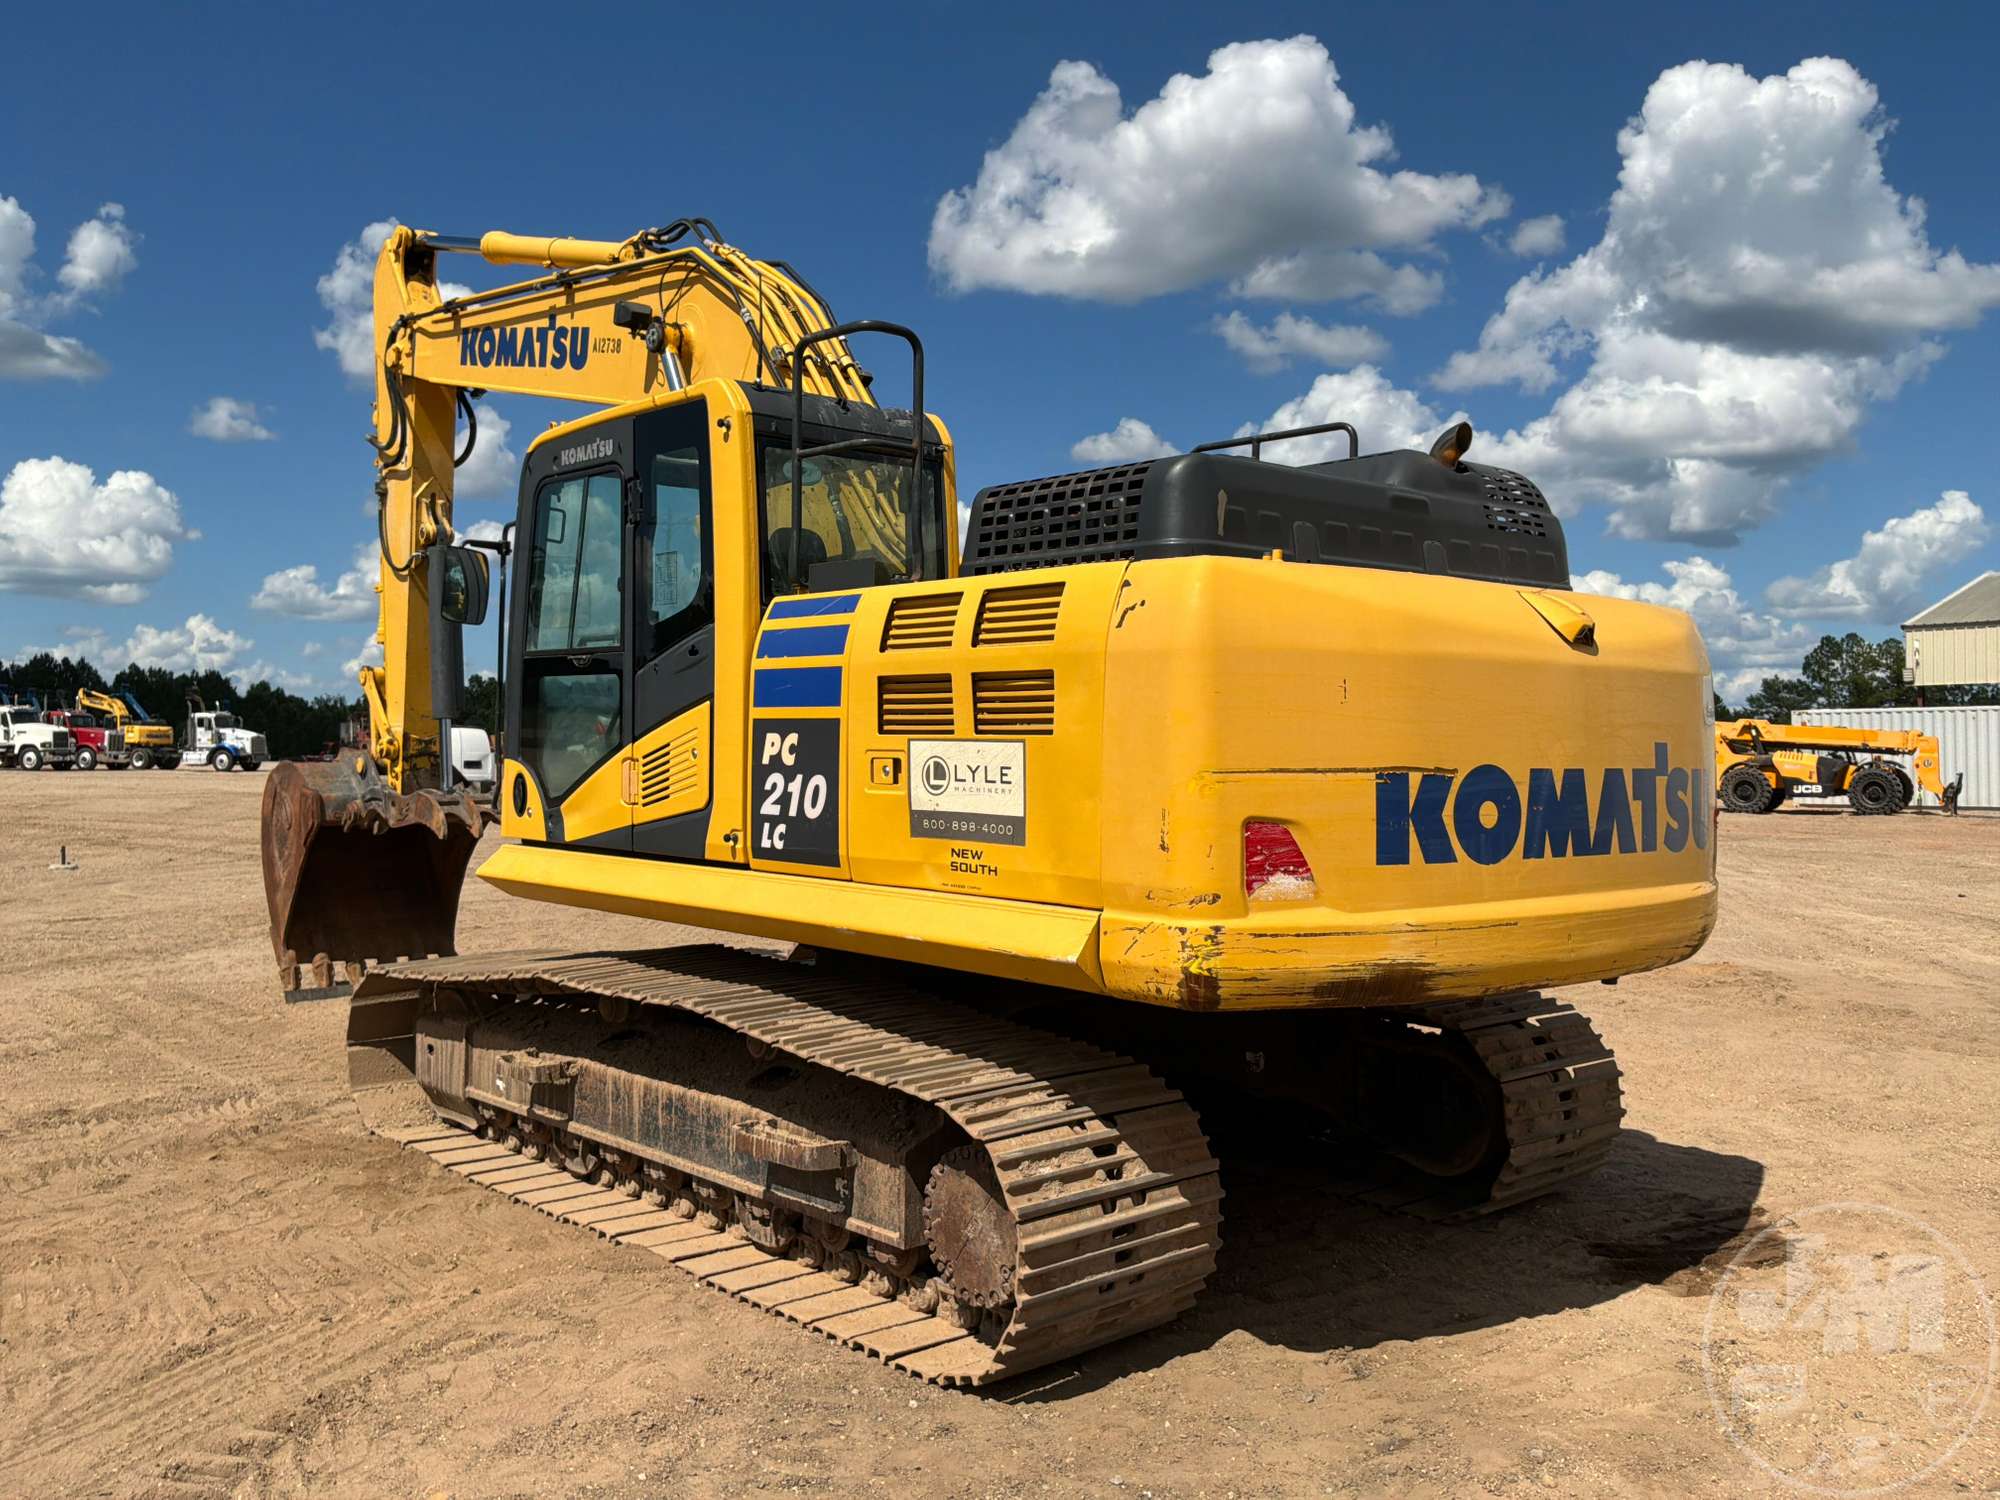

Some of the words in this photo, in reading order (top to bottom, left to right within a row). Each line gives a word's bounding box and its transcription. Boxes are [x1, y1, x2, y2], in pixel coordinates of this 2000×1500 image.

[460, 313, 591, 371] KOMATSU
[561, 437, 614, 466] KOMATSU
[761, 732, 799, 767] PC
[954, 764, 1012, 785] LYLE
[759, 772, 828, 820] 210
[954, 786, 1012, 796] MACHINERY
[1792, 784, 1823, 794] JCB
[1375, 742, 1708, 866] KOMATSU
[760, 822, 787, 850] LC
[922, 818, 1014, 836] 800-898-4000
[951, 848, 984, 860] NEW
[951, 861, 998, 877] SOUTH
